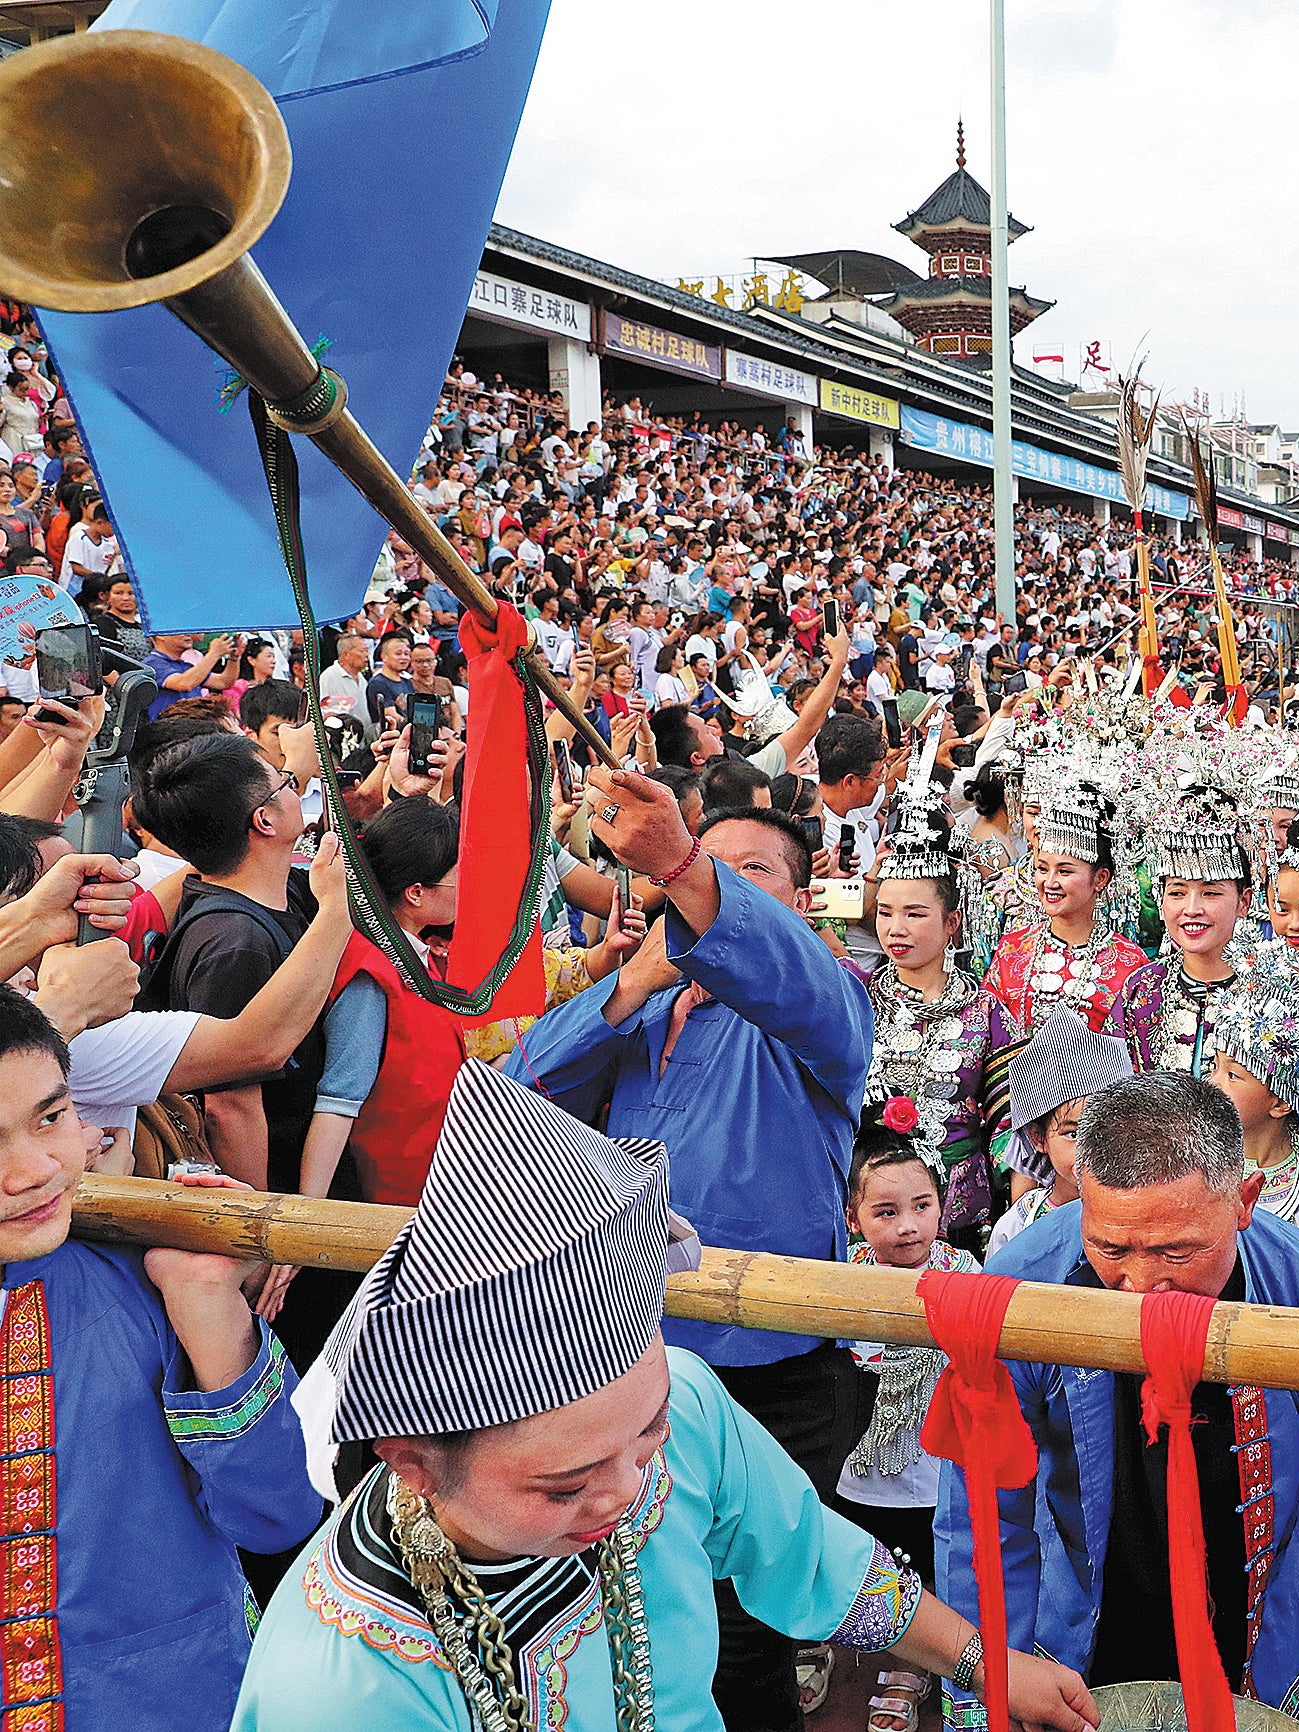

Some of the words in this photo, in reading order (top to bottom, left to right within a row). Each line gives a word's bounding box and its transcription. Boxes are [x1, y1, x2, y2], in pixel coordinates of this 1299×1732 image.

[475, 277, 578, 330] 江口寨足球队
